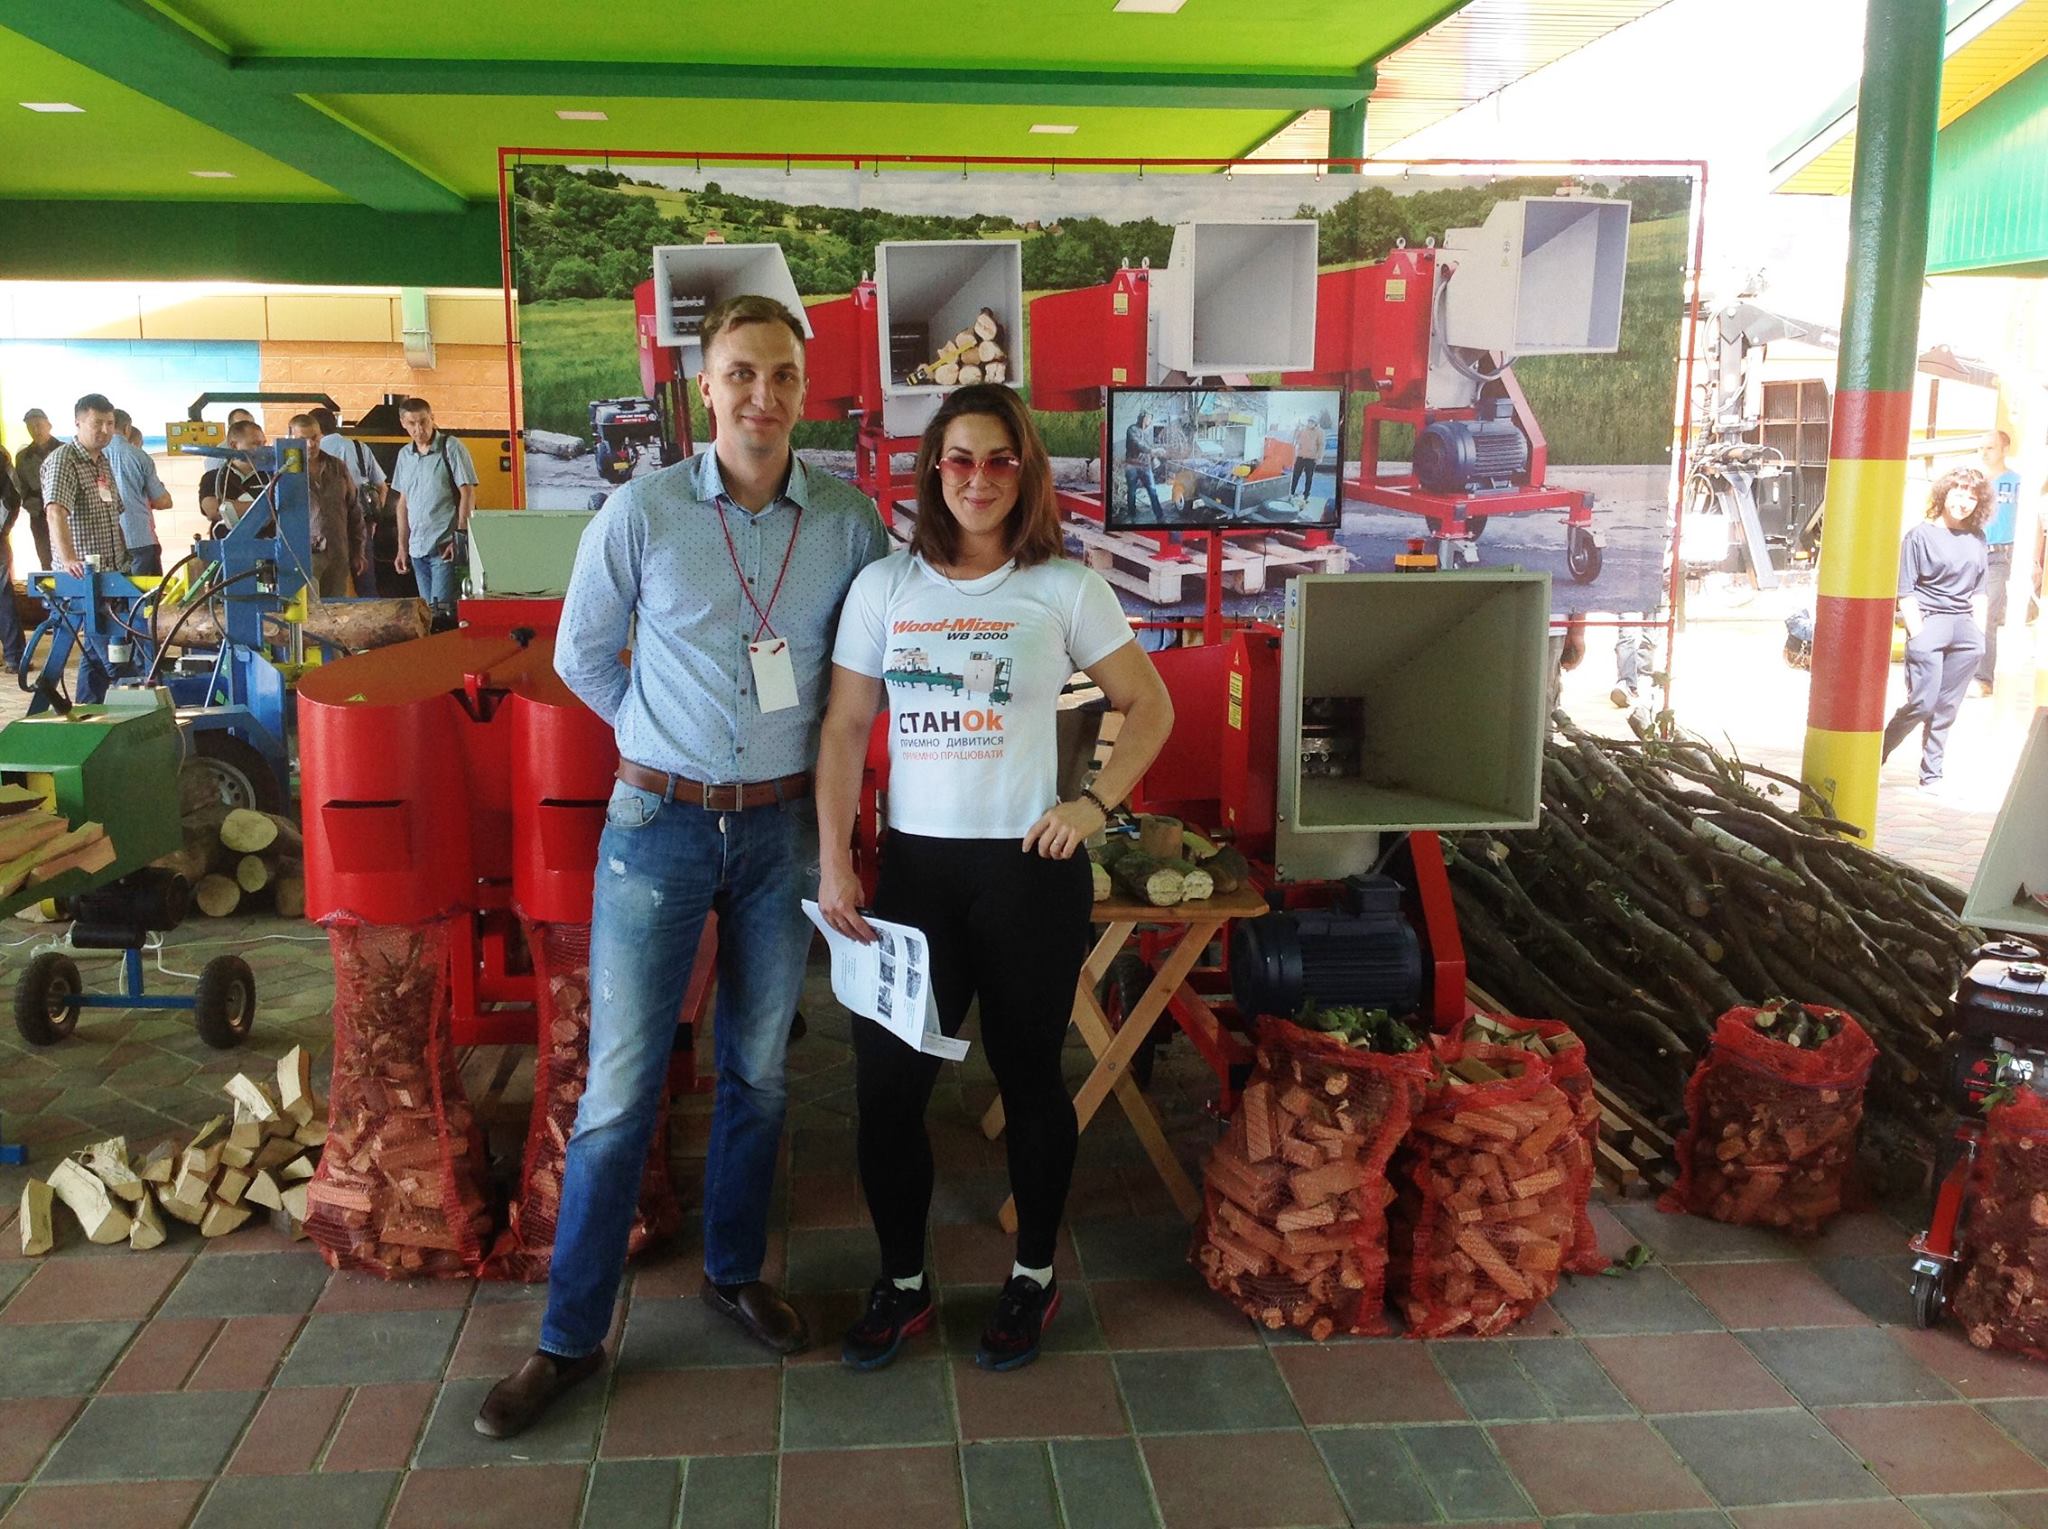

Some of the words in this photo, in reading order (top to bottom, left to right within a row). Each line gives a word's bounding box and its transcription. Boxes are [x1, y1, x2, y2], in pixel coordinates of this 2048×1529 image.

[893, 617, 1017, 635] Wood-Mizer
[947, 632, 970, 641] WB
[973, 632, 1009, 641] 2000
[900, 738, 940, 748] ПРИЄМНО
[946, 736, 1004, 748] ДИВИТИСЯ
[940, 749, 1003, 761] ПРАЦЮВАТИ
